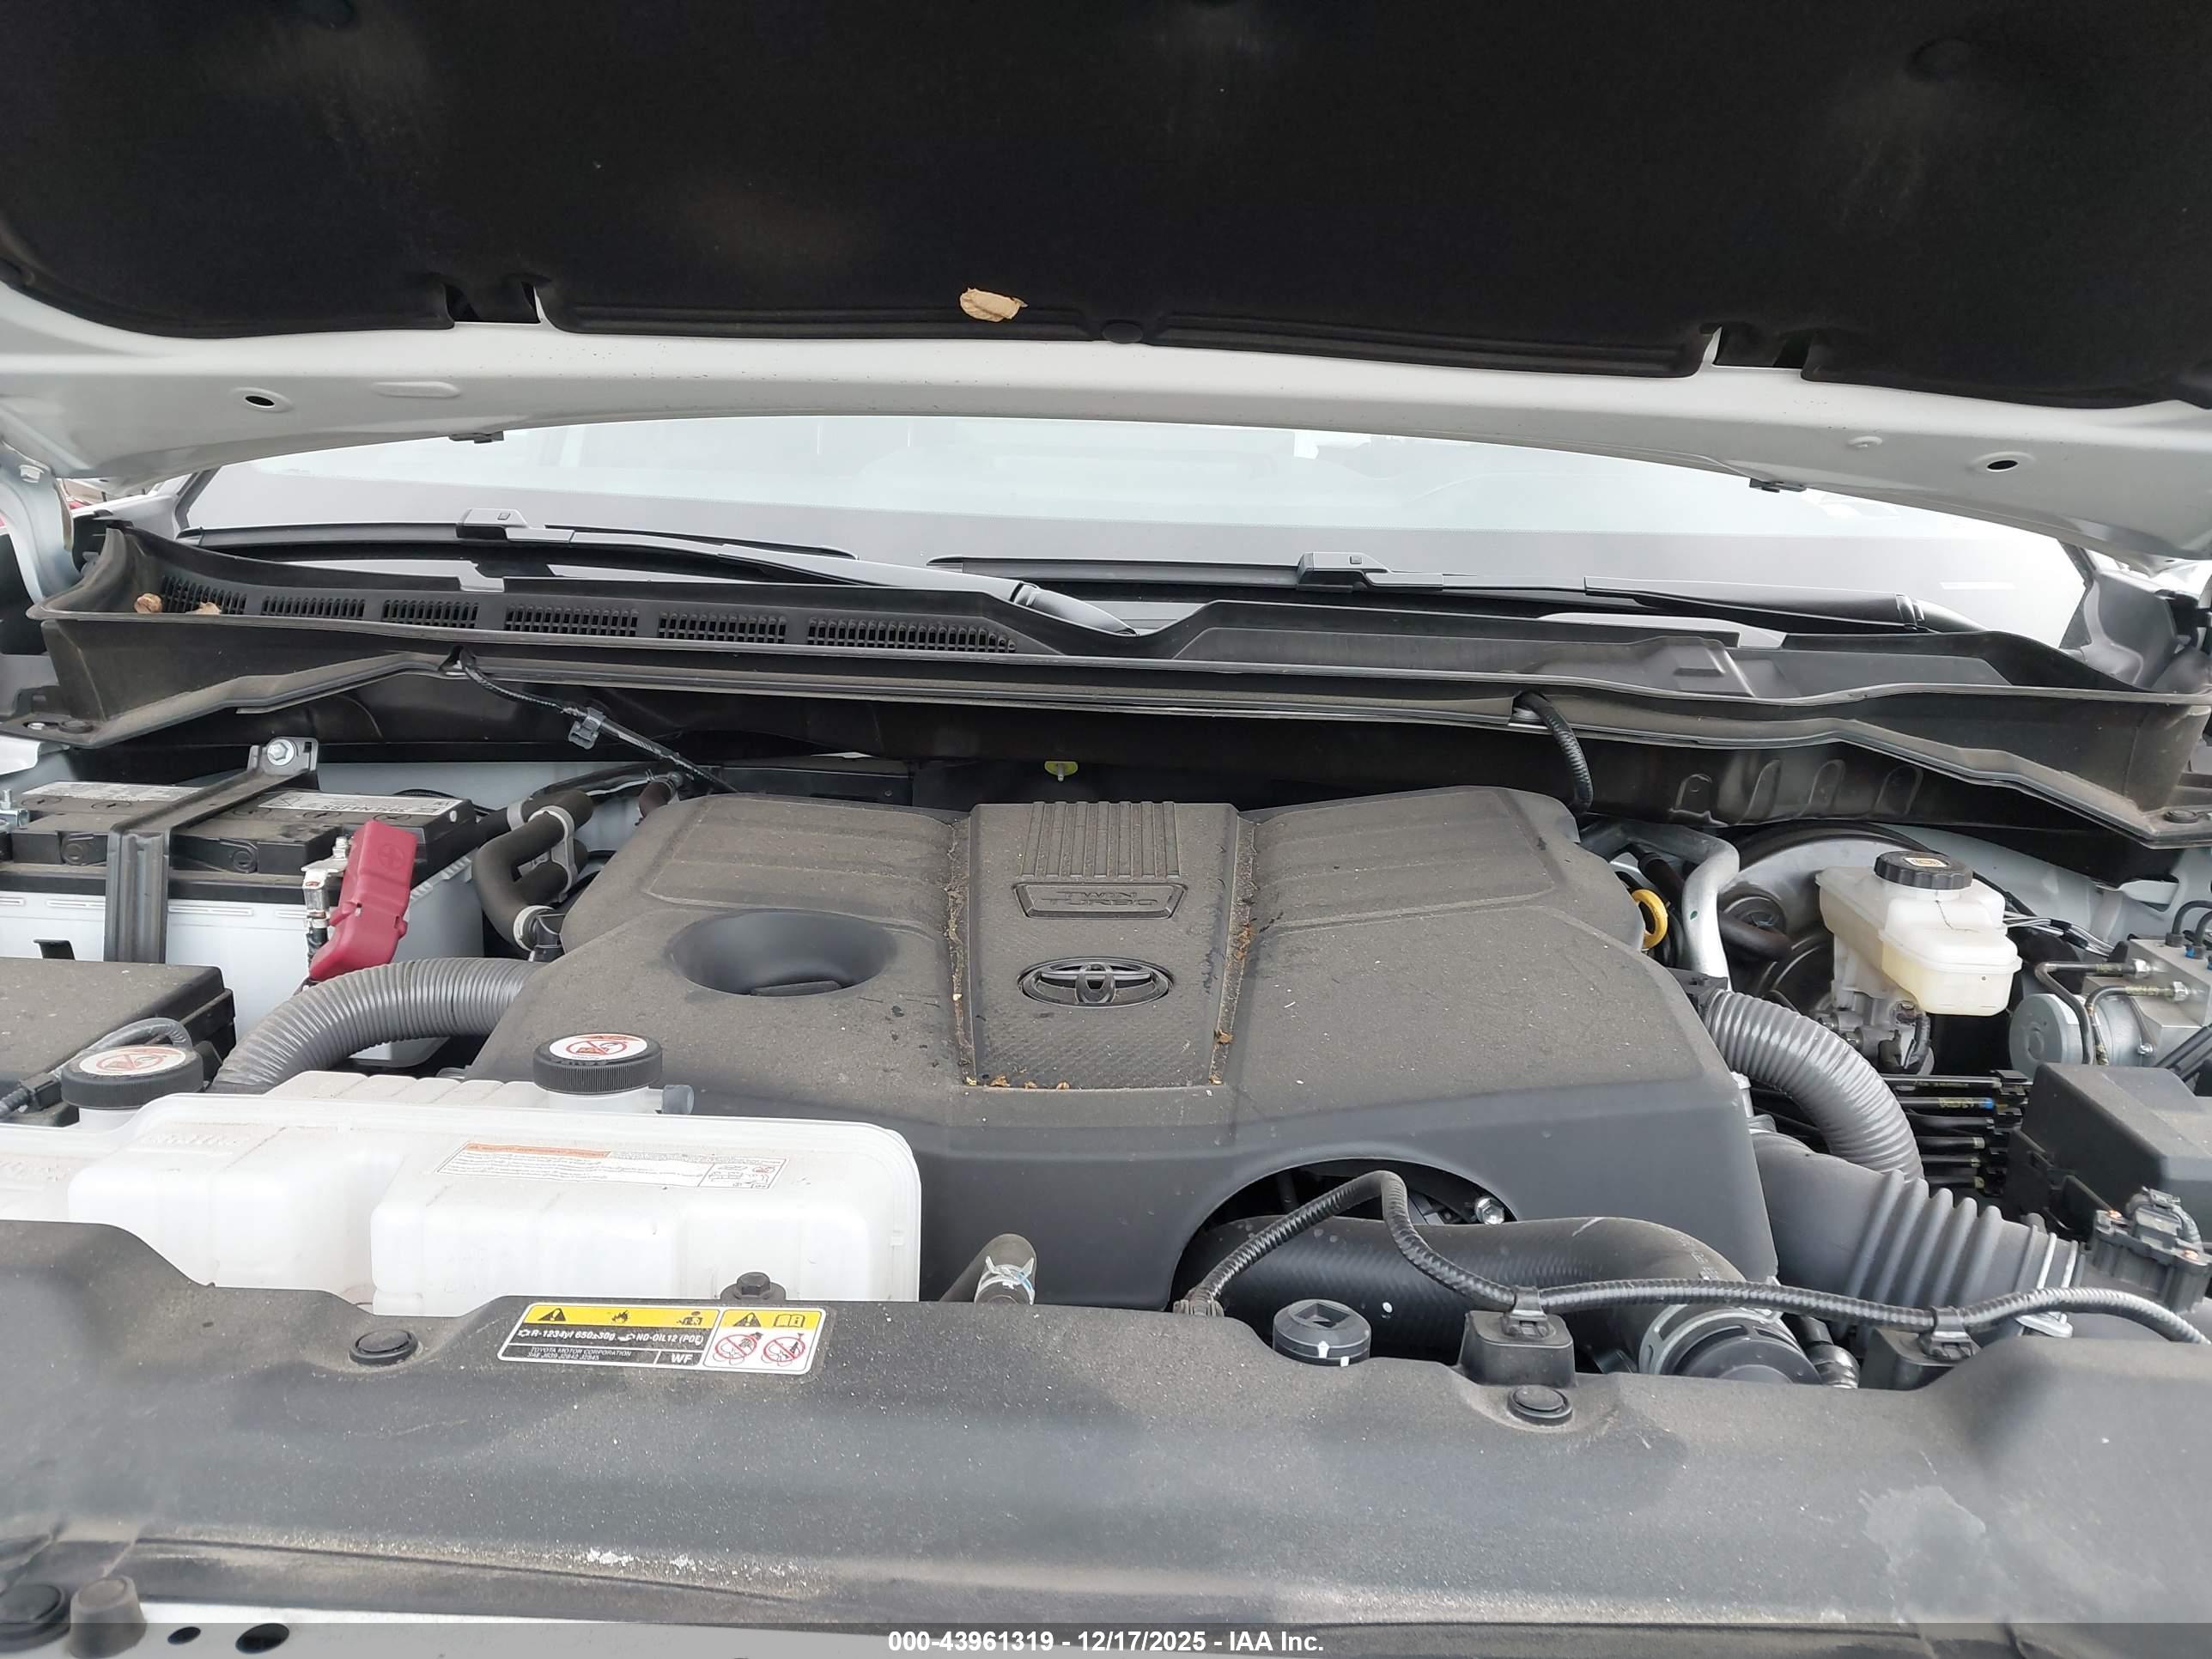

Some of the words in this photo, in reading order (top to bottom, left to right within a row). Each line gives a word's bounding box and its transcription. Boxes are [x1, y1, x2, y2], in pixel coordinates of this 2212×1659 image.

[531, 1329, 574, 1340] R-1234yf
[678, 1334, 704, 1346] (POE)
[671, 1352, 694, 1364] WF
